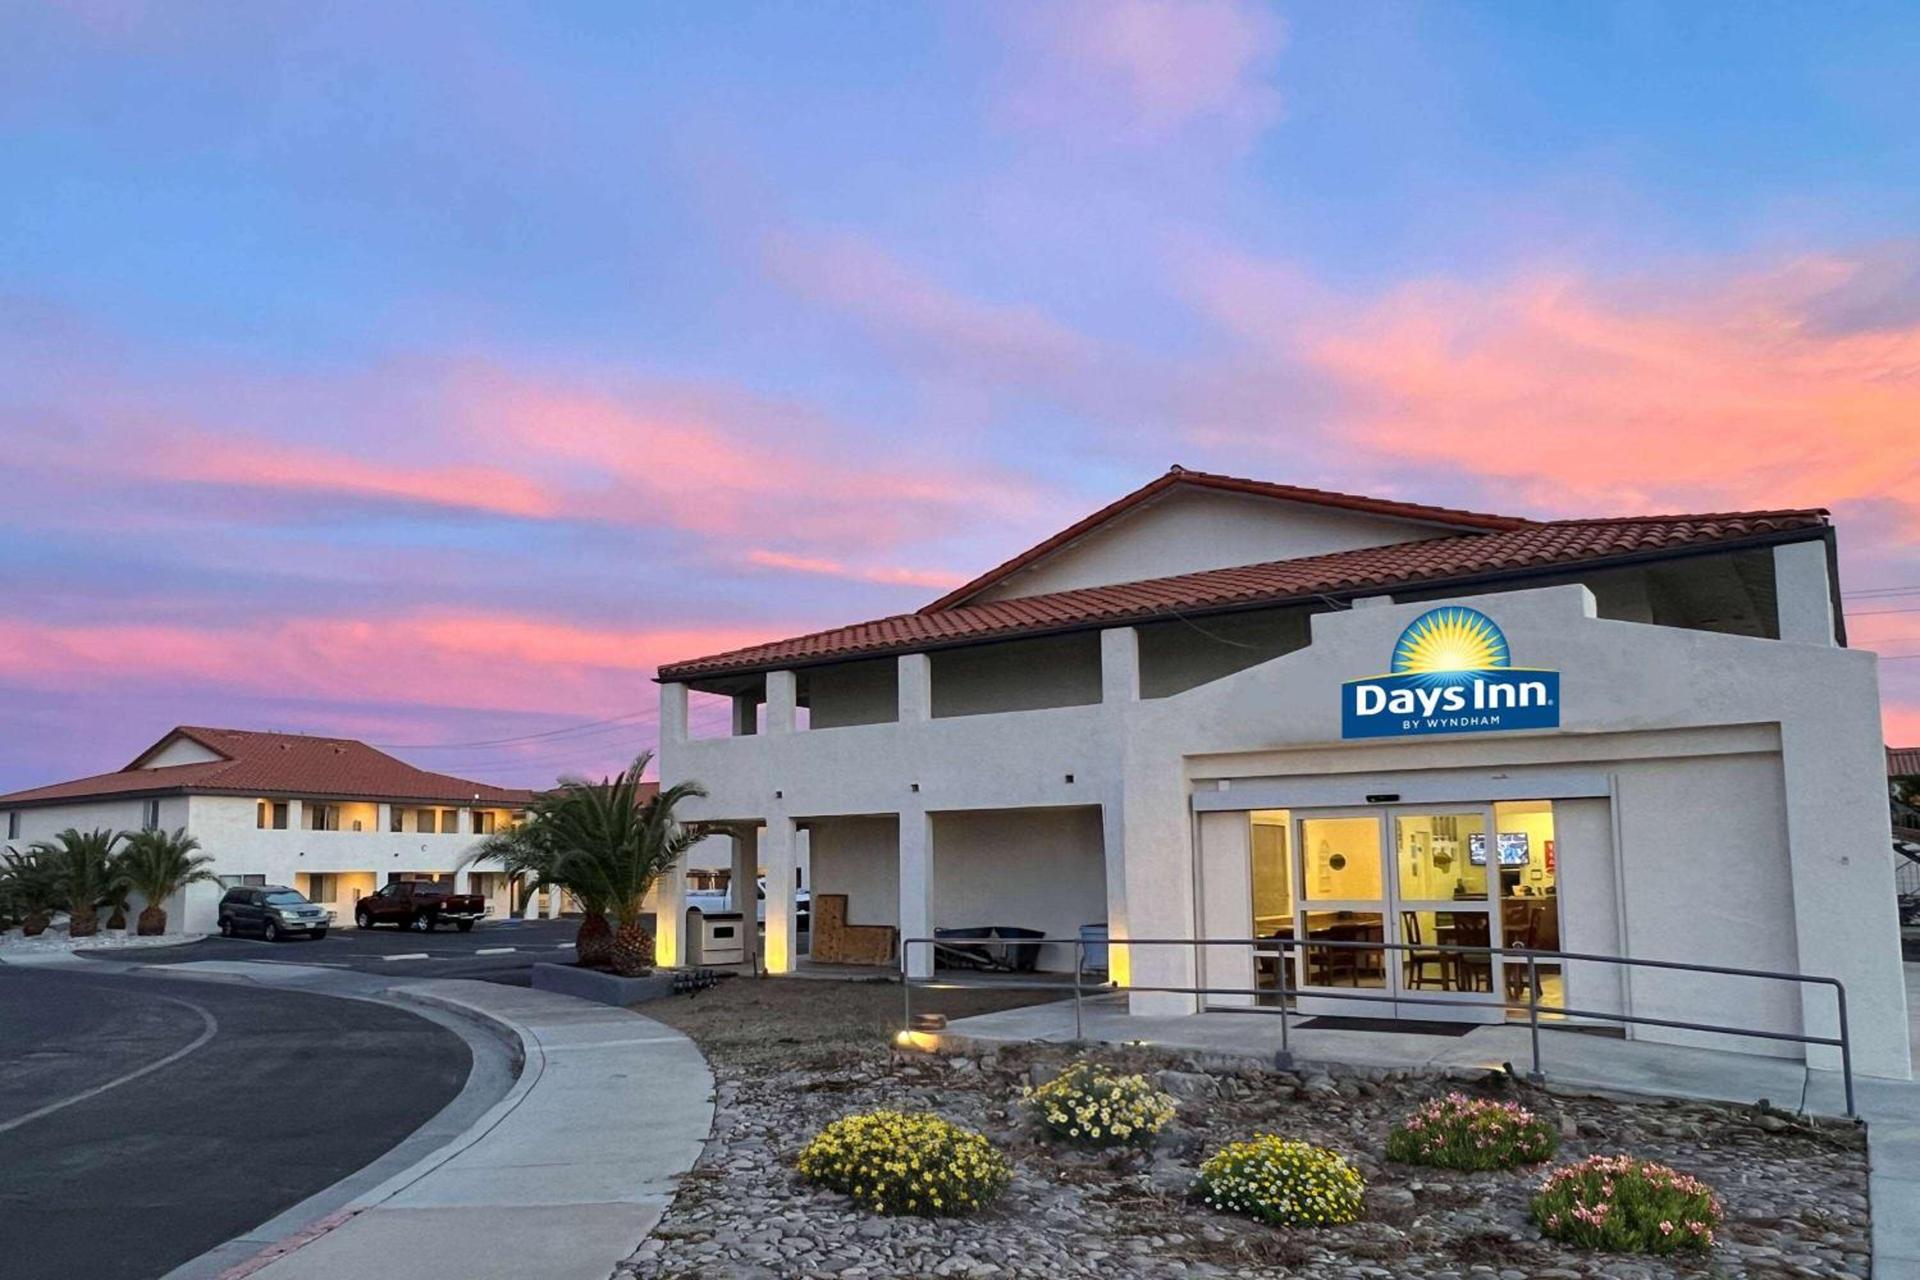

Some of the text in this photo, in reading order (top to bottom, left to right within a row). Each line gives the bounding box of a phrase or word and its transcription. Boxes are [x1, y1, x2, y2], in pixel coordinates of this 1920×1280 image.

[1356, 679, 1548, 717] Days Inn
[1403, 715, 1501, 730] BY WYNDHAM
